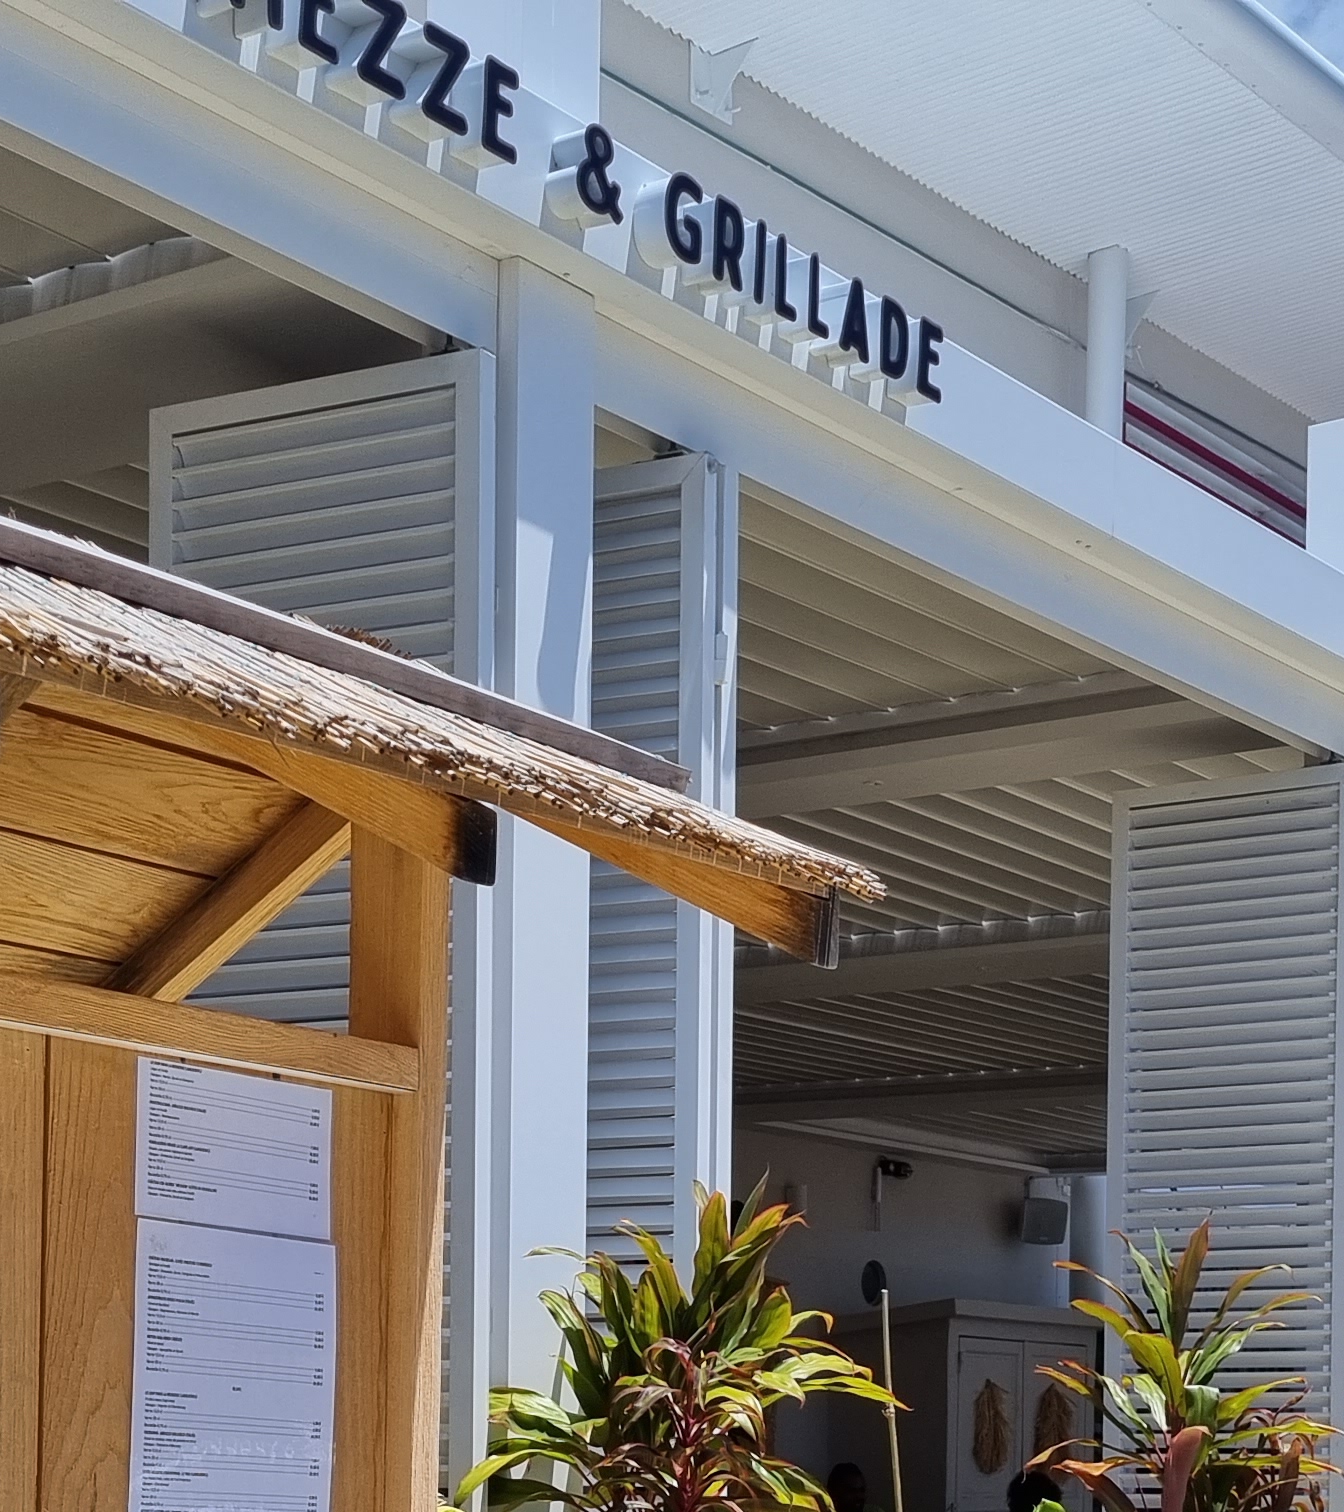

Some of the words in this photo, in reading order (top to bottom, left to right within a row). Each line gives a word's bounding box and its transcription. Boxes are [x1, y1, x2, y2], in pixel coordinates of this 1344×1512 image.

[231, 0, 519, 165] EZZE
[576, 124, 623, 225] &
[664, 172, 944, 404] GRILLADE
